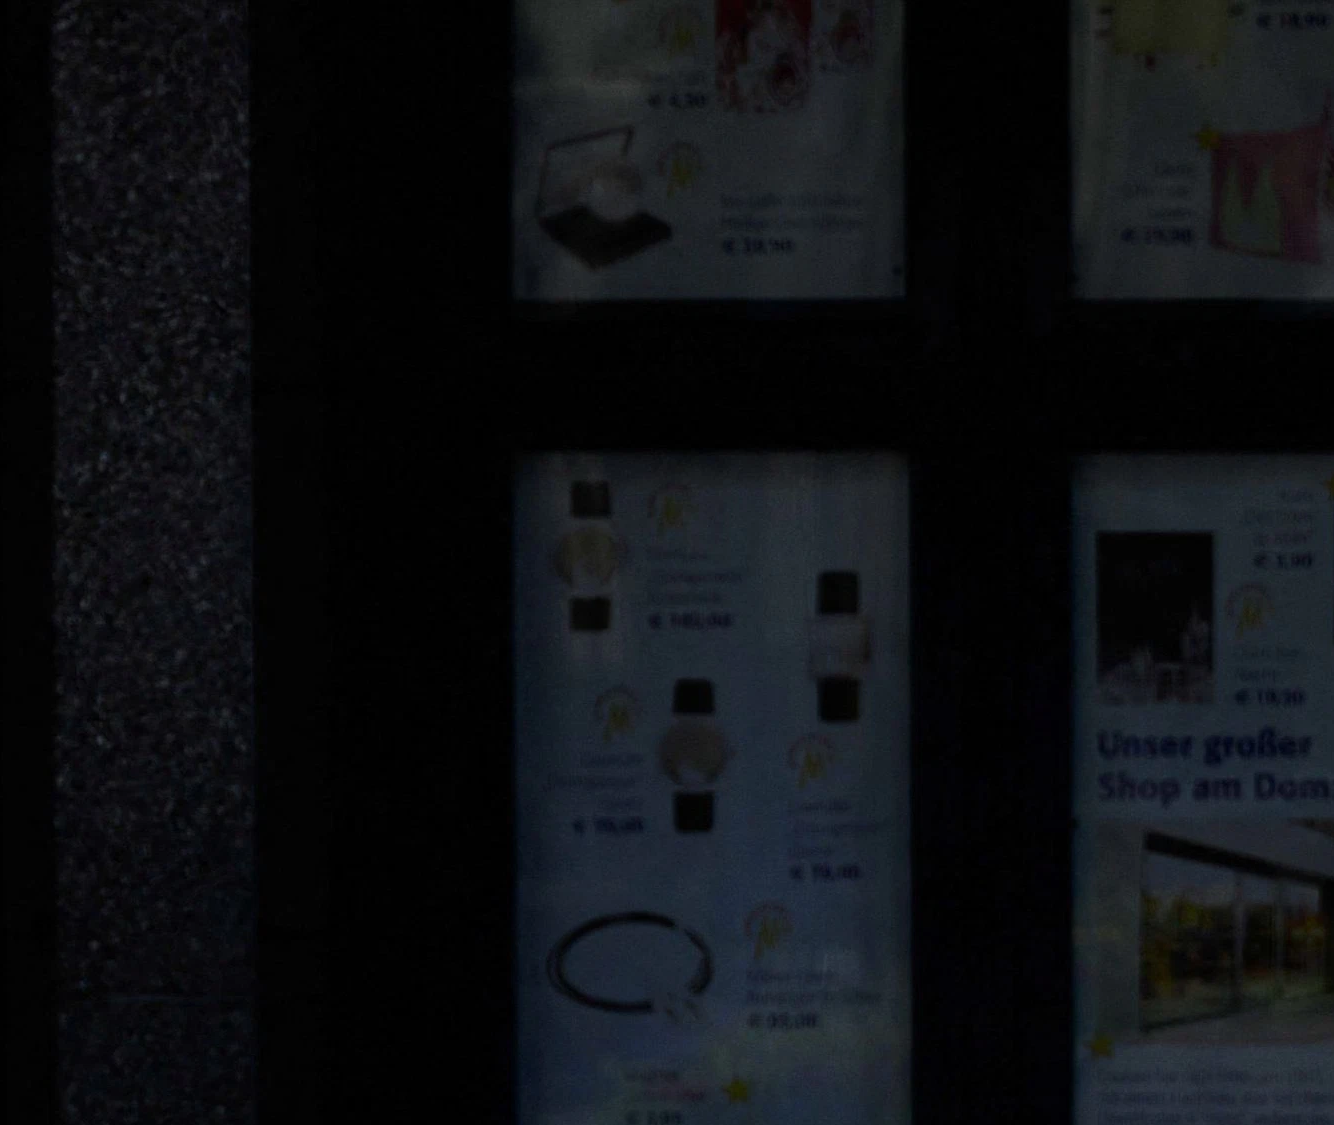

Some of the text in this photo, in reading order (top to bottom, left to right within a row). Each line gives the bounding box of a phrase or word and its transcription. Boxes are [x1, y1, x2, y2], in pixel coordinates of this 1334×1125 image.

[1096, 725, 1313, 767] Unser großer
[1097, 771, 1181, 809] Shop
[1192, 778, 1242, 800] am
